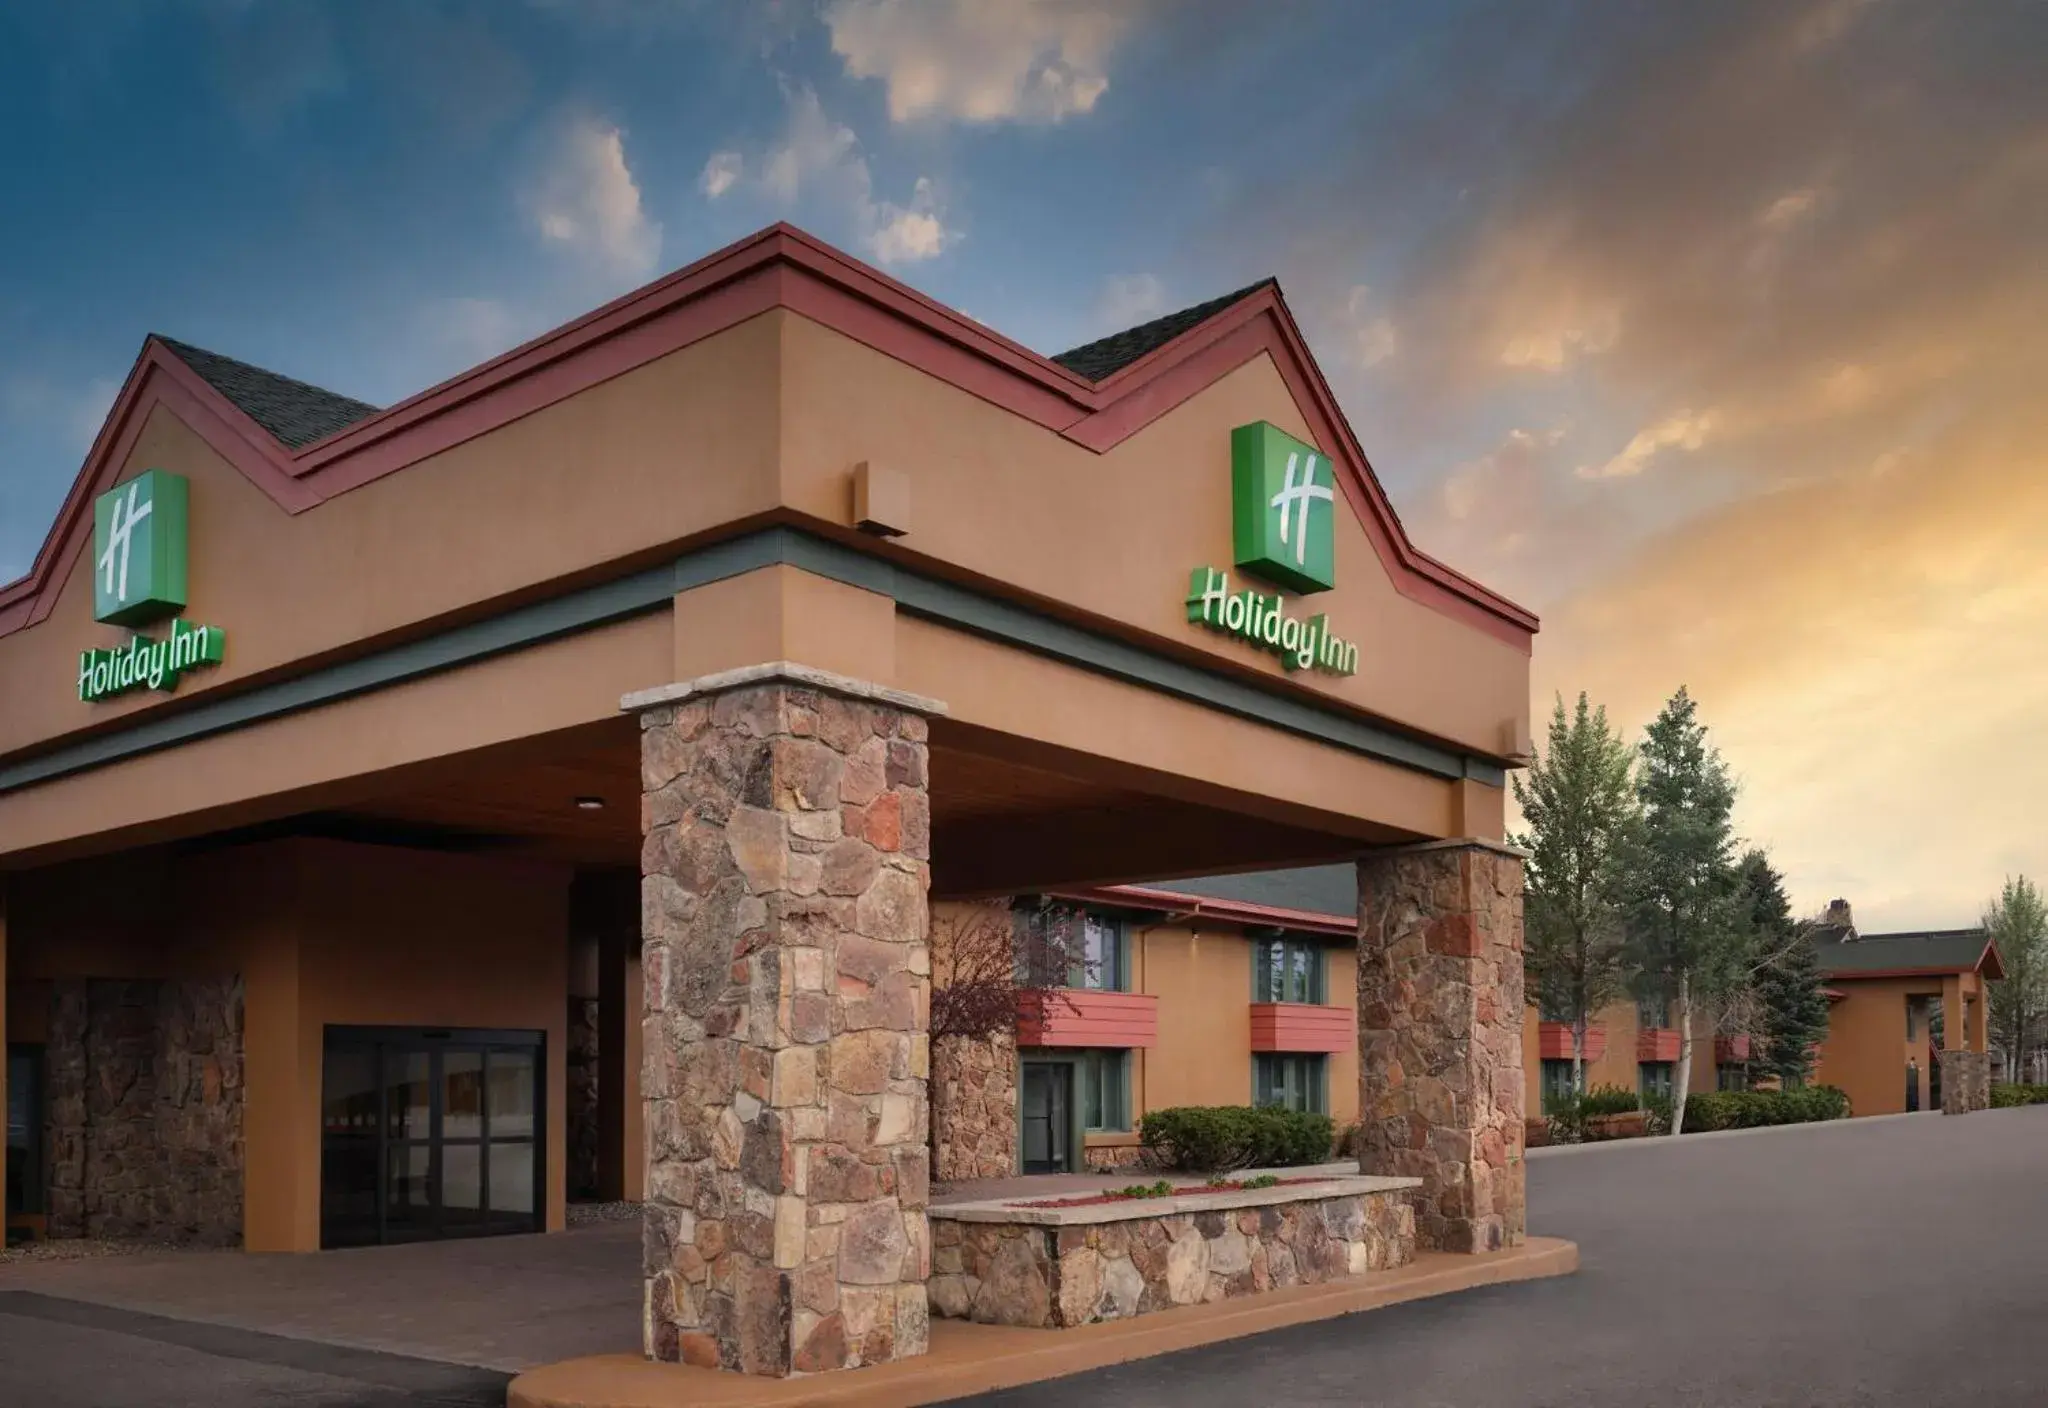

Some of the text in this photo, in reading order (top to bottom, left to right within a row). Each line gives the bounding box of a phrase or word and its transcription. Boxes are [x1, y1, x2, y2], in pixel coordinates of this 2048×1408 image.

[77, 618, 207, 701] Holiday Inn
[1201, 566, 1359, 675] Holiday Inn
